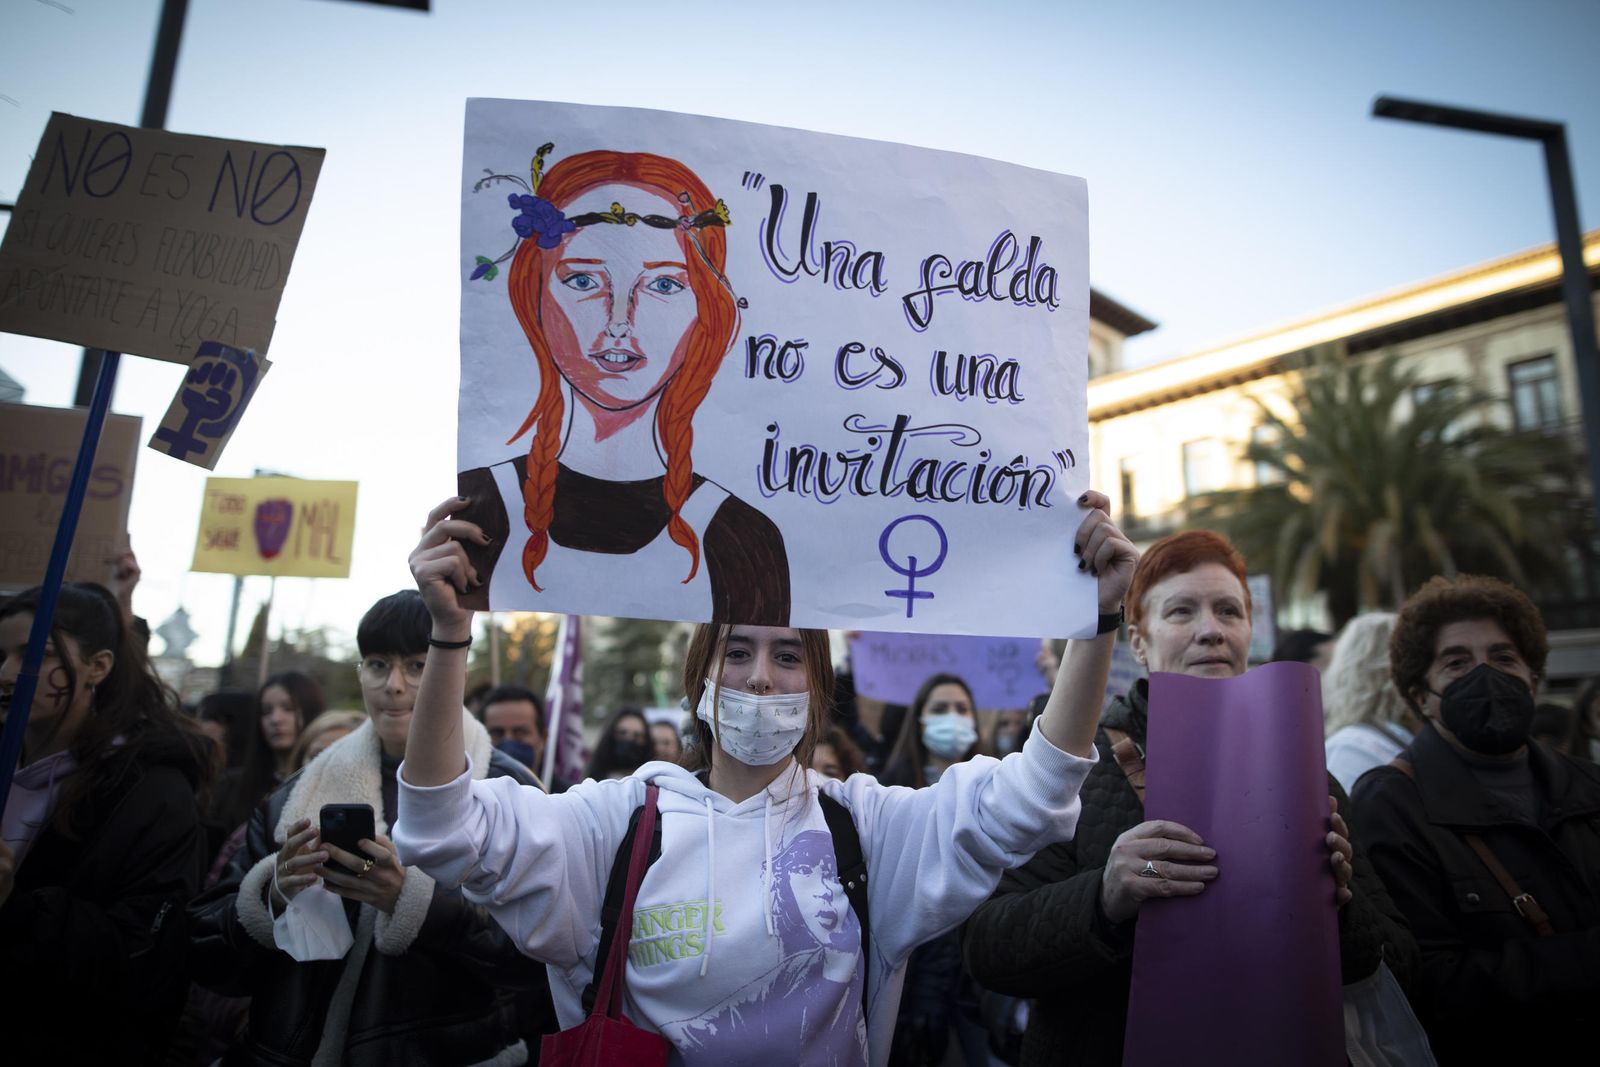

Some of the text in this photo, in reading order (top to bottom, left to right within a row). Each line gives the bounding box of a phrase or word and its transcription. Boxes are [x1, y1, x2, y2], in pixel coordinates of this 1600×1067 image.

[139, 152, 194, 200] ES
[902, 229, 1060, 333] falda
[136, 287, 162, 333] A
[170, 288, 239, 346] YOGA
[745, 333, 1025, 404] no es una
